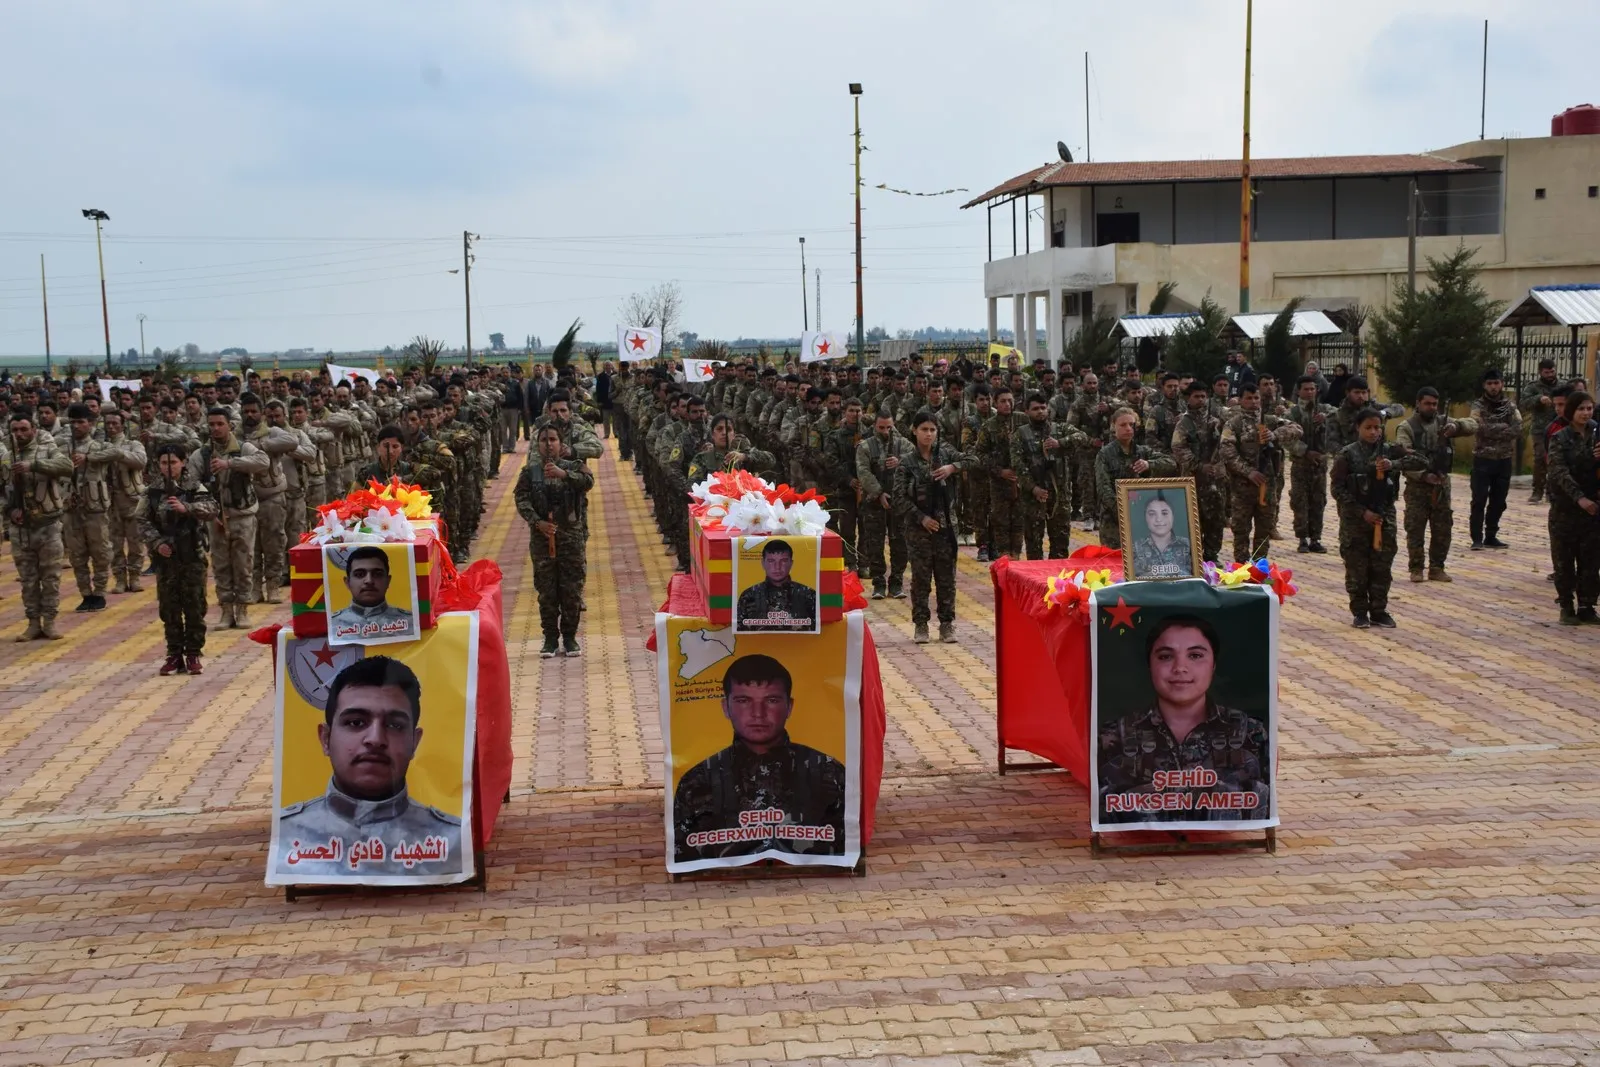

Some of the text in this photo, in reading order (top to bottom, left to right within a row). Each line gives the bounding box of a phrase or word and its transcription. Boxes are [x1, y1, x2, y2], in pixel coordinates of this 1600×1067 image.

[336, 619, 408, 637] الشهيد فادي الحسن
[1153, 766, 1217, 791] ŞEHÎD
[1106, 792, 1259, 813] RUKSEN AMED
[739, 807, 784, 827] ŞEHÎD
[688, 825, 835, 846] CEGERXWÎN HESEKÊ
[287, 836, 448, 868] الشهيد فادي الحسن
